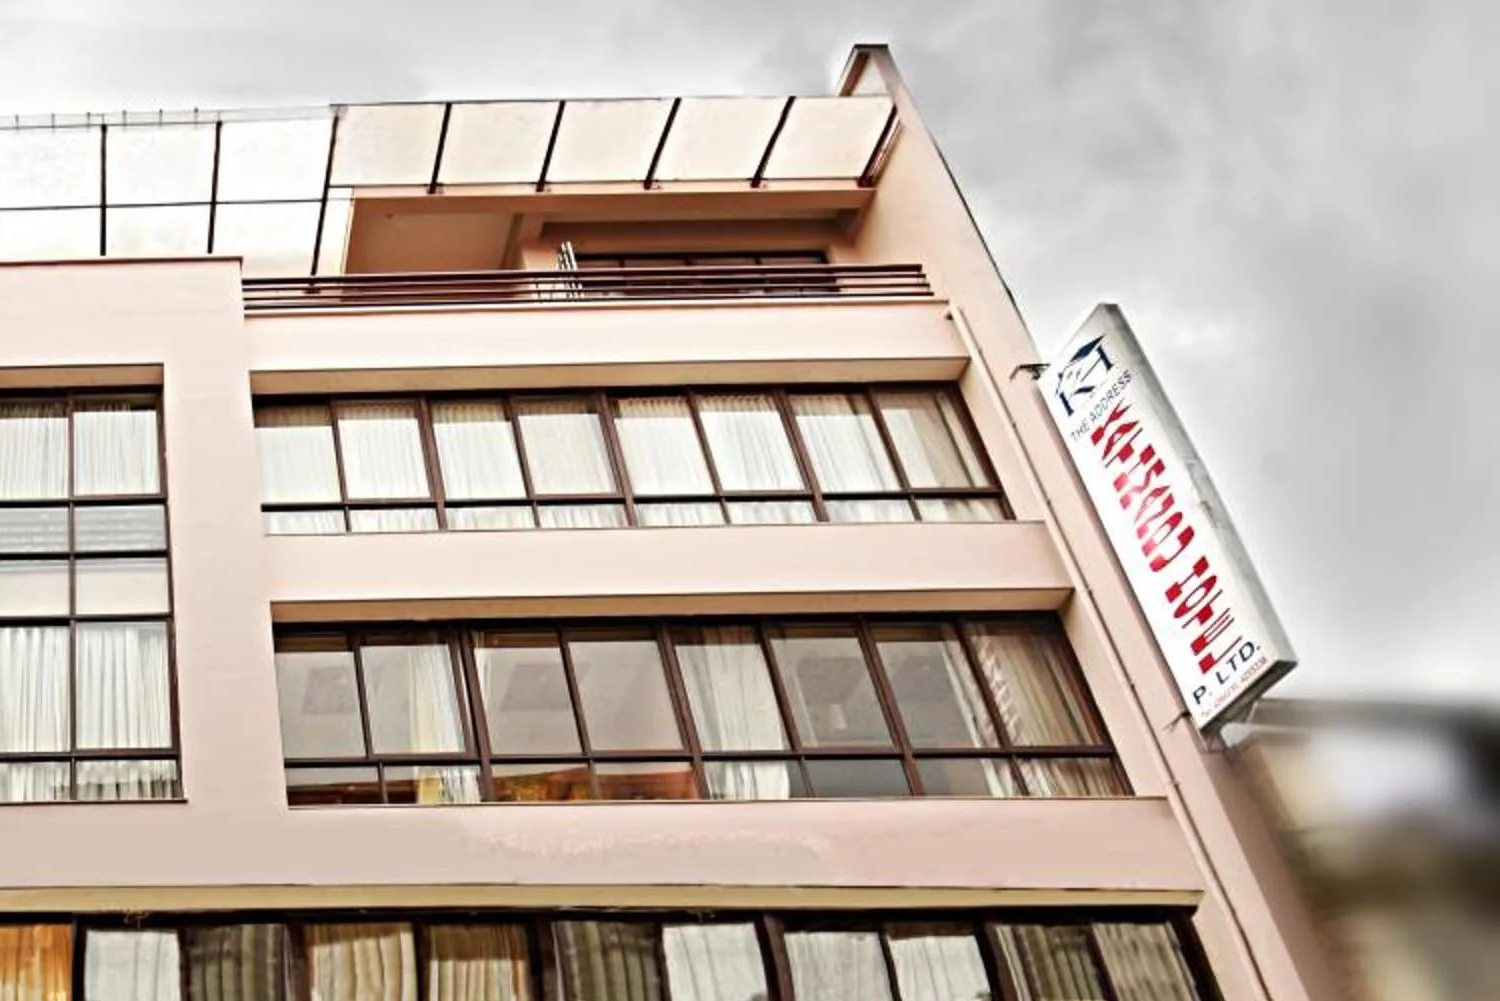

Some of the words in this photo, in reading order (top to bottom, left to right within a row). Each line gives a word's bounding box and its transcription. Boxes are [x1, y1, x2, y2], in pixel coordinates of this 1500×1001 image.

[1070, 418, 1091, 442] THE
[1089, 369, 1132, 422] ADDRESS
[1215, 641, 1260, 685] LTD.
